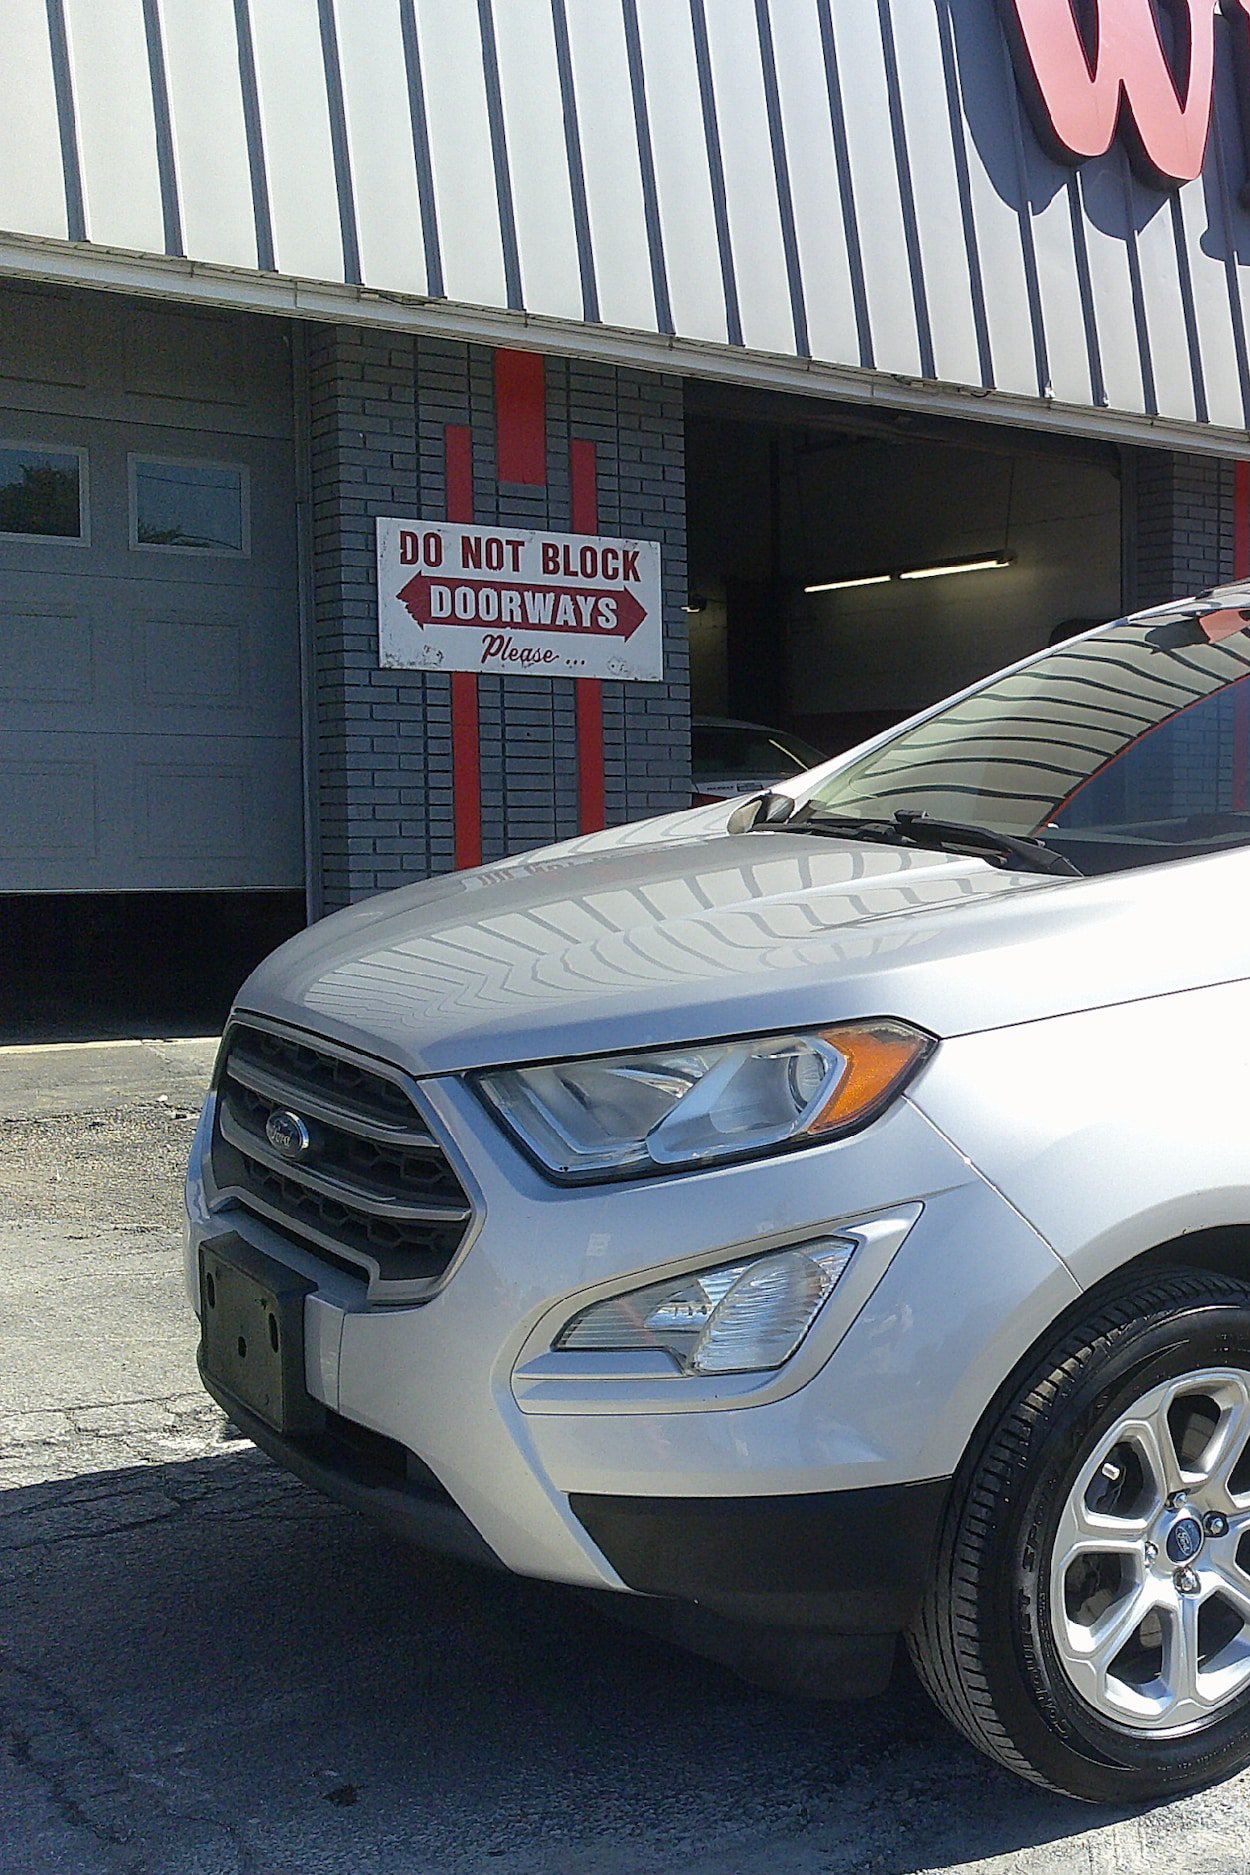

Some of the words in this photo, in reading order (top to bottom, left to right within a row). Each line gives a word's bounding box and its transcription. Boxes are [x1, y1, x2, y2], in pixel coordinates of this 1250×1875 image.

[400, 530, 442, 568] DO
[461, 535, 525, 573] NOT
[541, 542, 641, 582] BLOCK
[430, 584, 618, 629] DOORWAYS
[480, 634, 559, 664] Please
